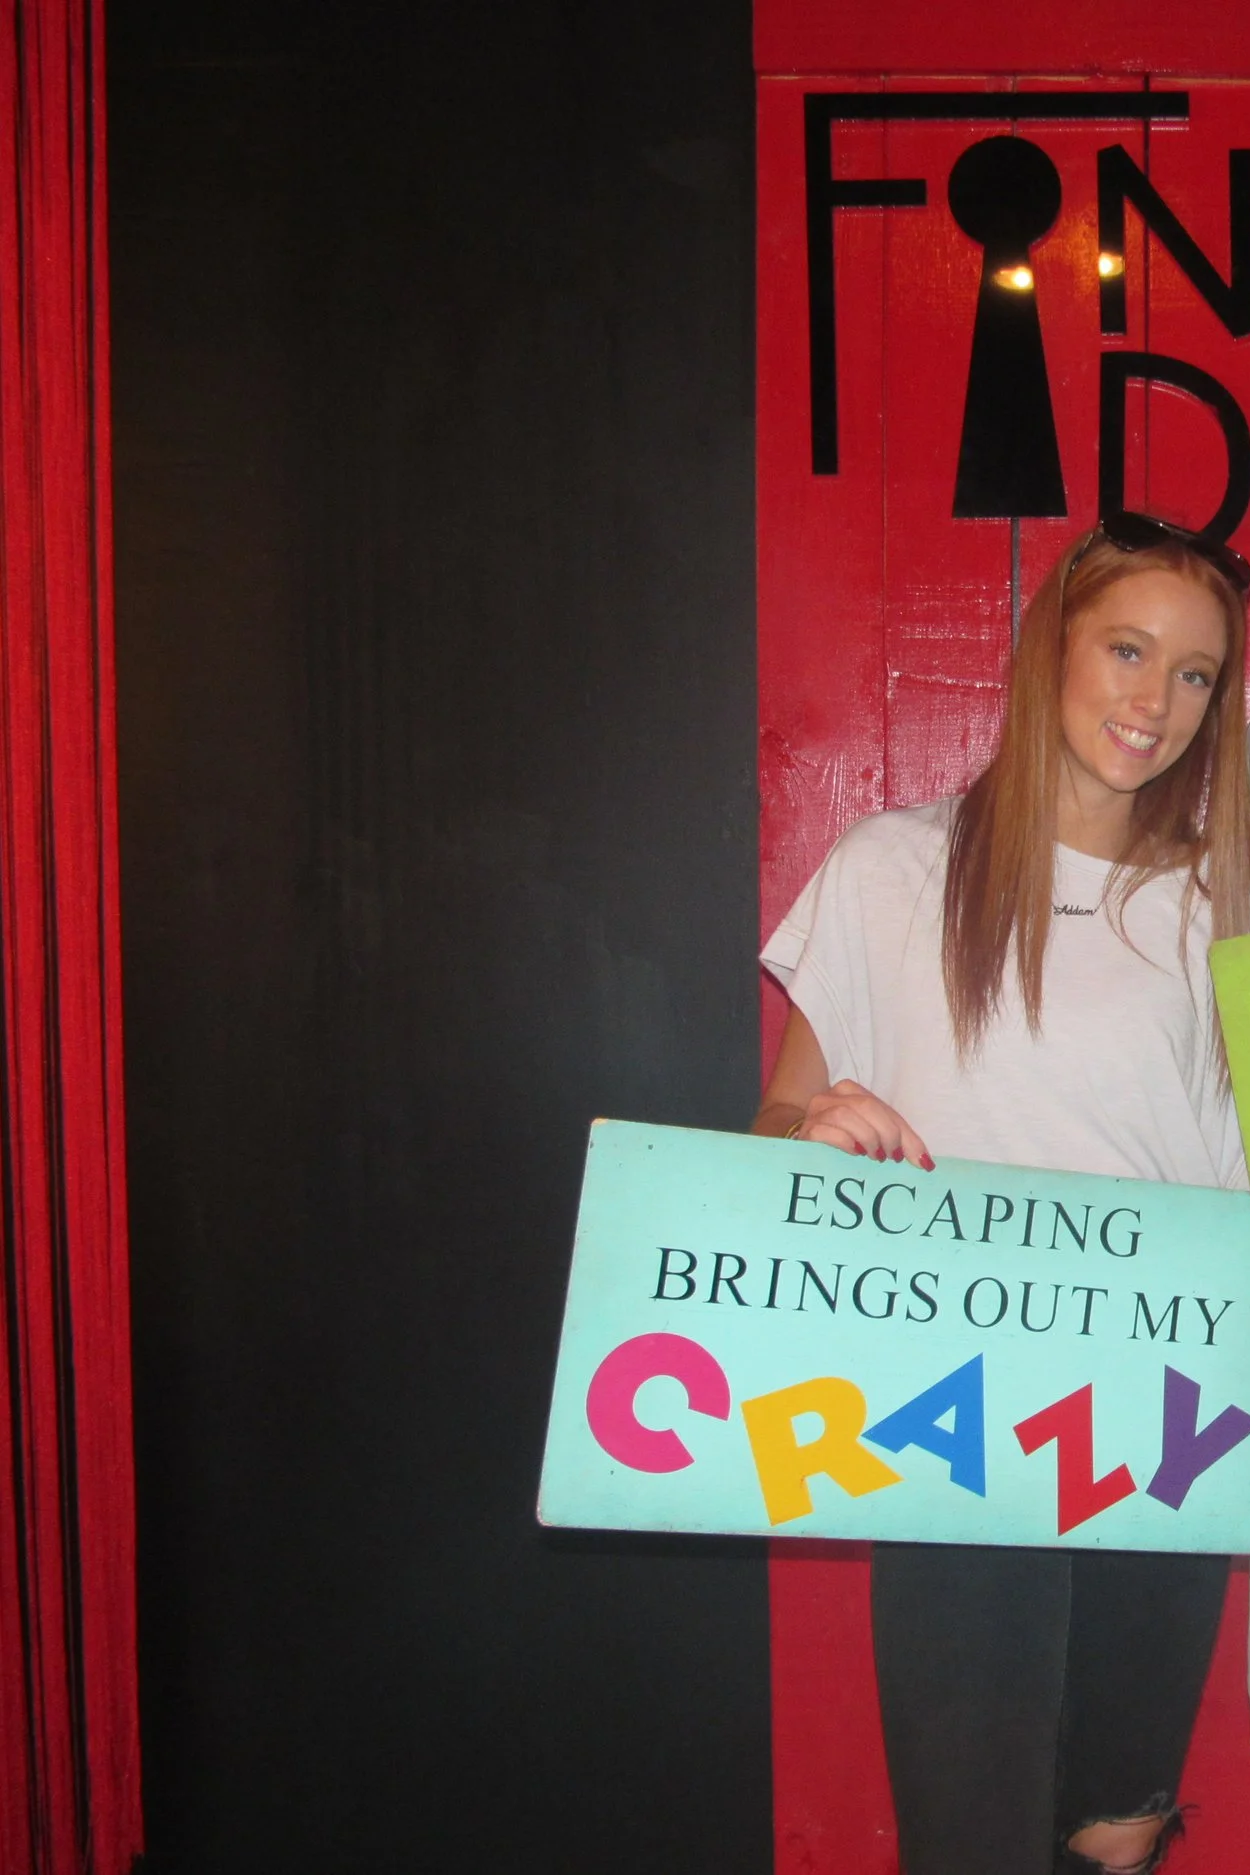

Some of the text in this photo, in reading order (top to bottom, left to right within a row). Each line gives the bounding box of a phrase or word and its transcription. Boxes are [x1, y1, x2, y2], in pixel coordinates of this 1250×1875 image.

[785, 1172, 1144, 1258] ESCAPING
[650, 1247, 1235, 1346] BRINGS OUT MY
